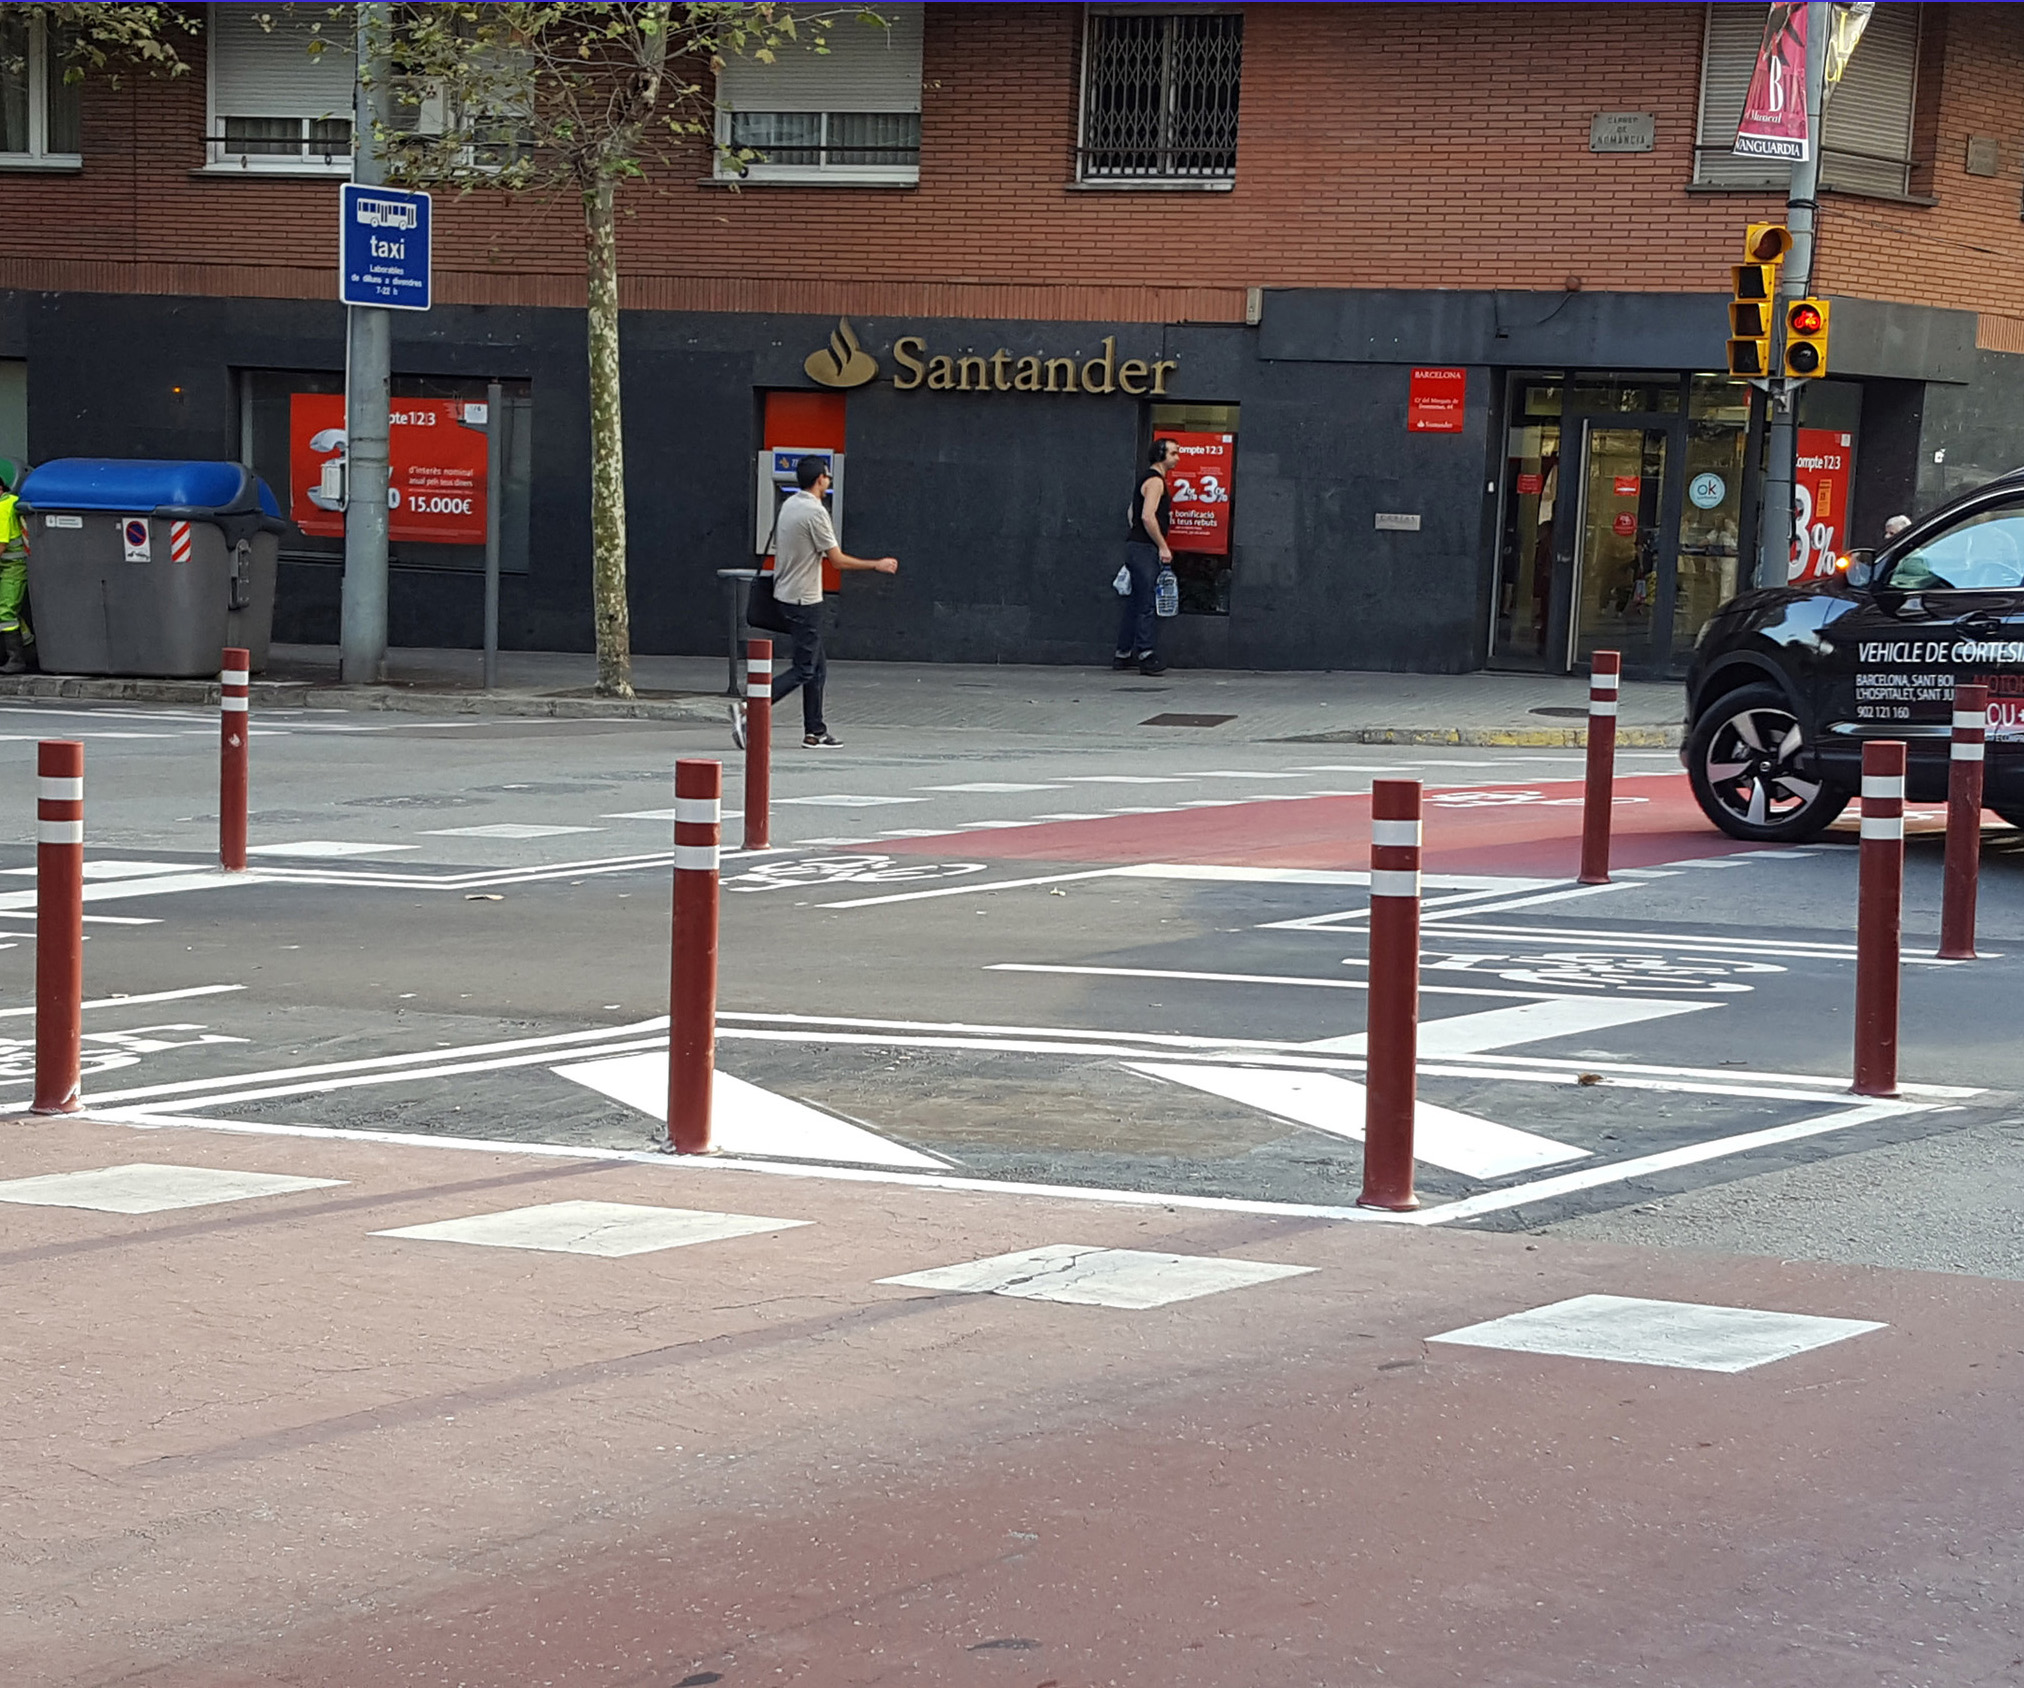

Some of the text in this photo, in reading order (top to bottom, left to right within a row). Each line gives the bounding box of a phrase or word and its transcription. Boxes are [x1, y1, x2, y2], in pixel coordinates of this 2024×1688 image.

[369, 235, 405, 260] taxi
[893, 335, 1178, 396] Santander
[1414, 371, 1461, 379] BARCELONA
[1179, 446, 1205, 456] ompte
[1697, 480, 1717, 495] ok
[408, 496, 473, 515] 15.000€
[1175, 509, 1215, 519] bonificació
[1194, 519, 1218, 527] rebuts
[1858, 642, 1924, 662] VEHICLE
[1925, 642, 1949, 662] DE
[1855, 674, 1910, 688] BARCELONA,
[1911, 674, 1936, 687] SANT
[1855, 688, 1955, 702] L'HOSPITALET, SANT JU
[1857, 706, 1910, 719] 902 121 160
[1986, 703, 2015, 727] OU
